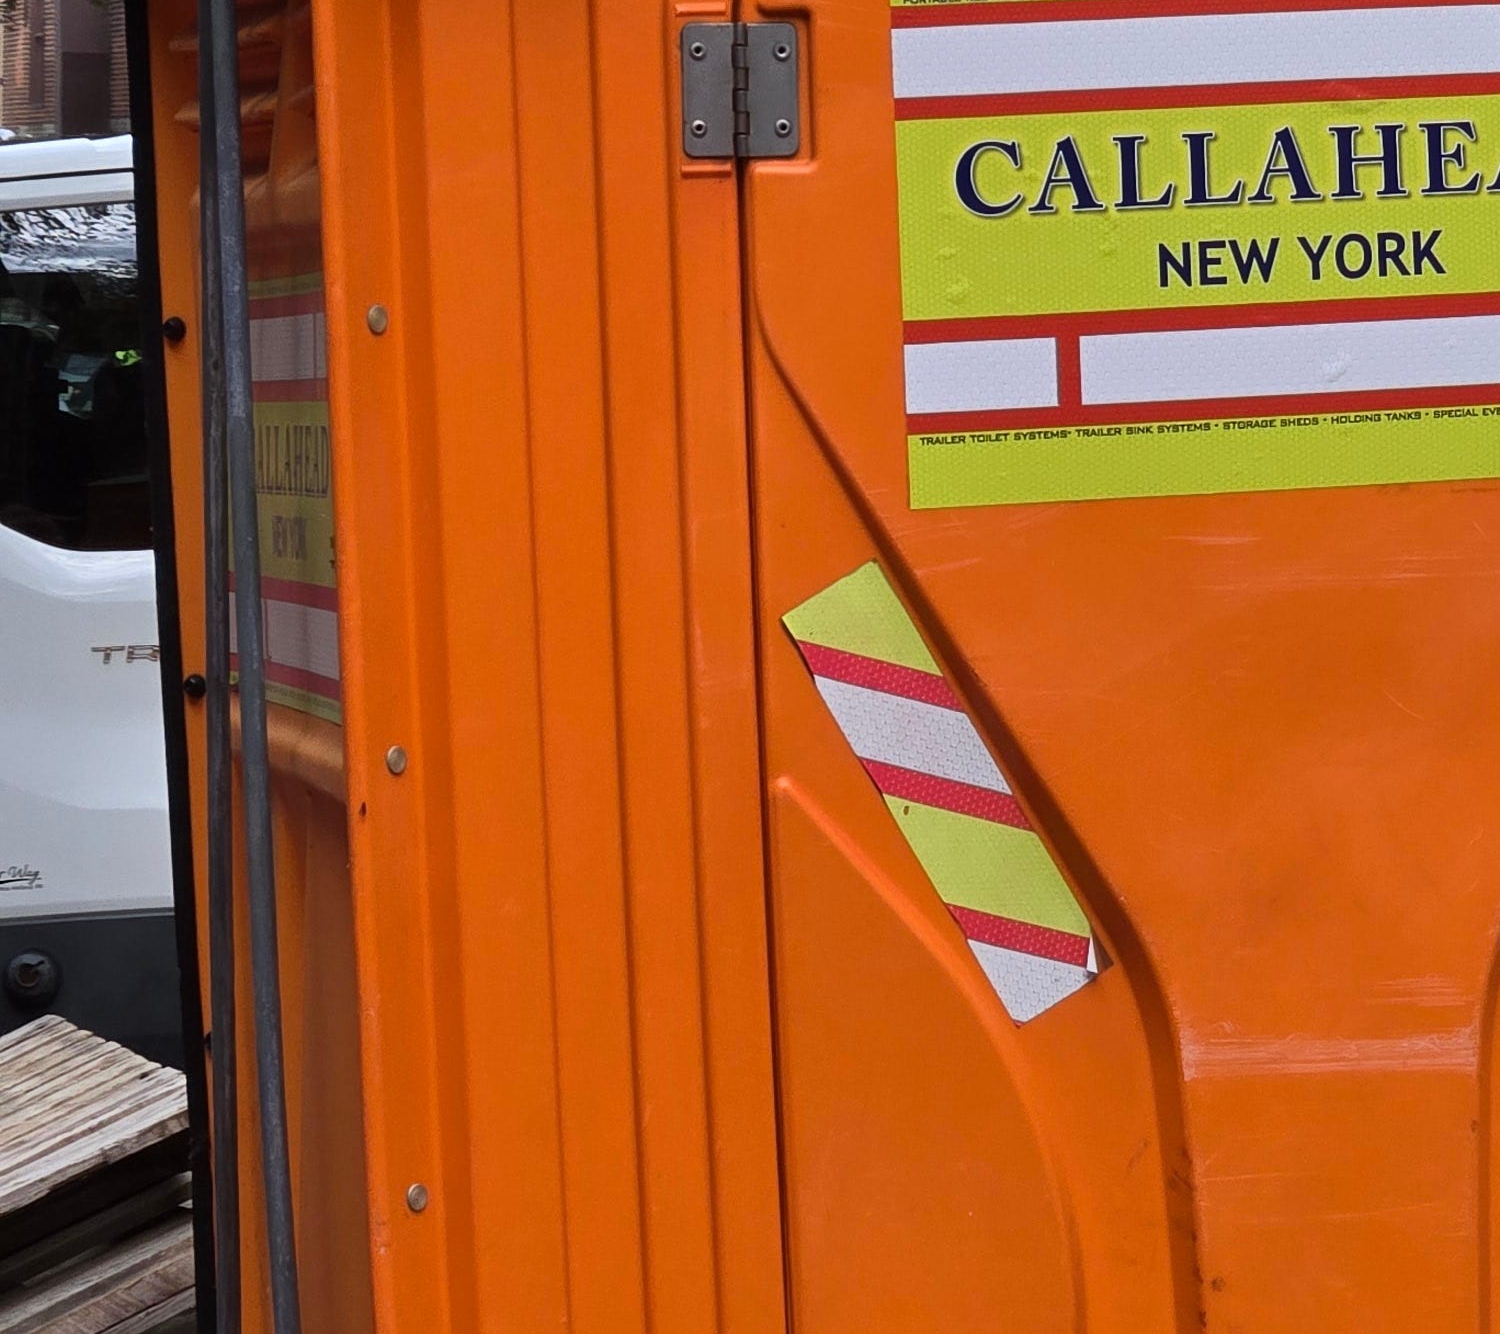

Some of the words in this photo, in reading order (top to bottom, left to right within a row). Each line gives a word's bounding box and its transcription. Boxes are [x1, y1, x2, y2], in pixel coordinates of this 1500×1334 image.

[1157, 237, 1281, 289] NEW
[1297, 230, 1447, 283] YORK
[919, 434, 966, 446] TRAILER
[969, 432, 1010, 444] TOILET
[1013, 430, 1068, 442] SYSTEMS
[1076, 426, 1122, 438] TRAILER
[1126, 425, 1153, 436] SINK
[1157, 422, 1211, 434] SYSTEMS
[1222, 419, 1277, 431] STORAGE
[1280, 416, 1319, 428] SHEDS
[1331, 413, 1382, 425] HOLDING
[1384, 410, 1422, 422] TANKS
[1433, 407, 1478, 419] SPECIAL
[255, 424, 330, 498] ALLAHEAD
